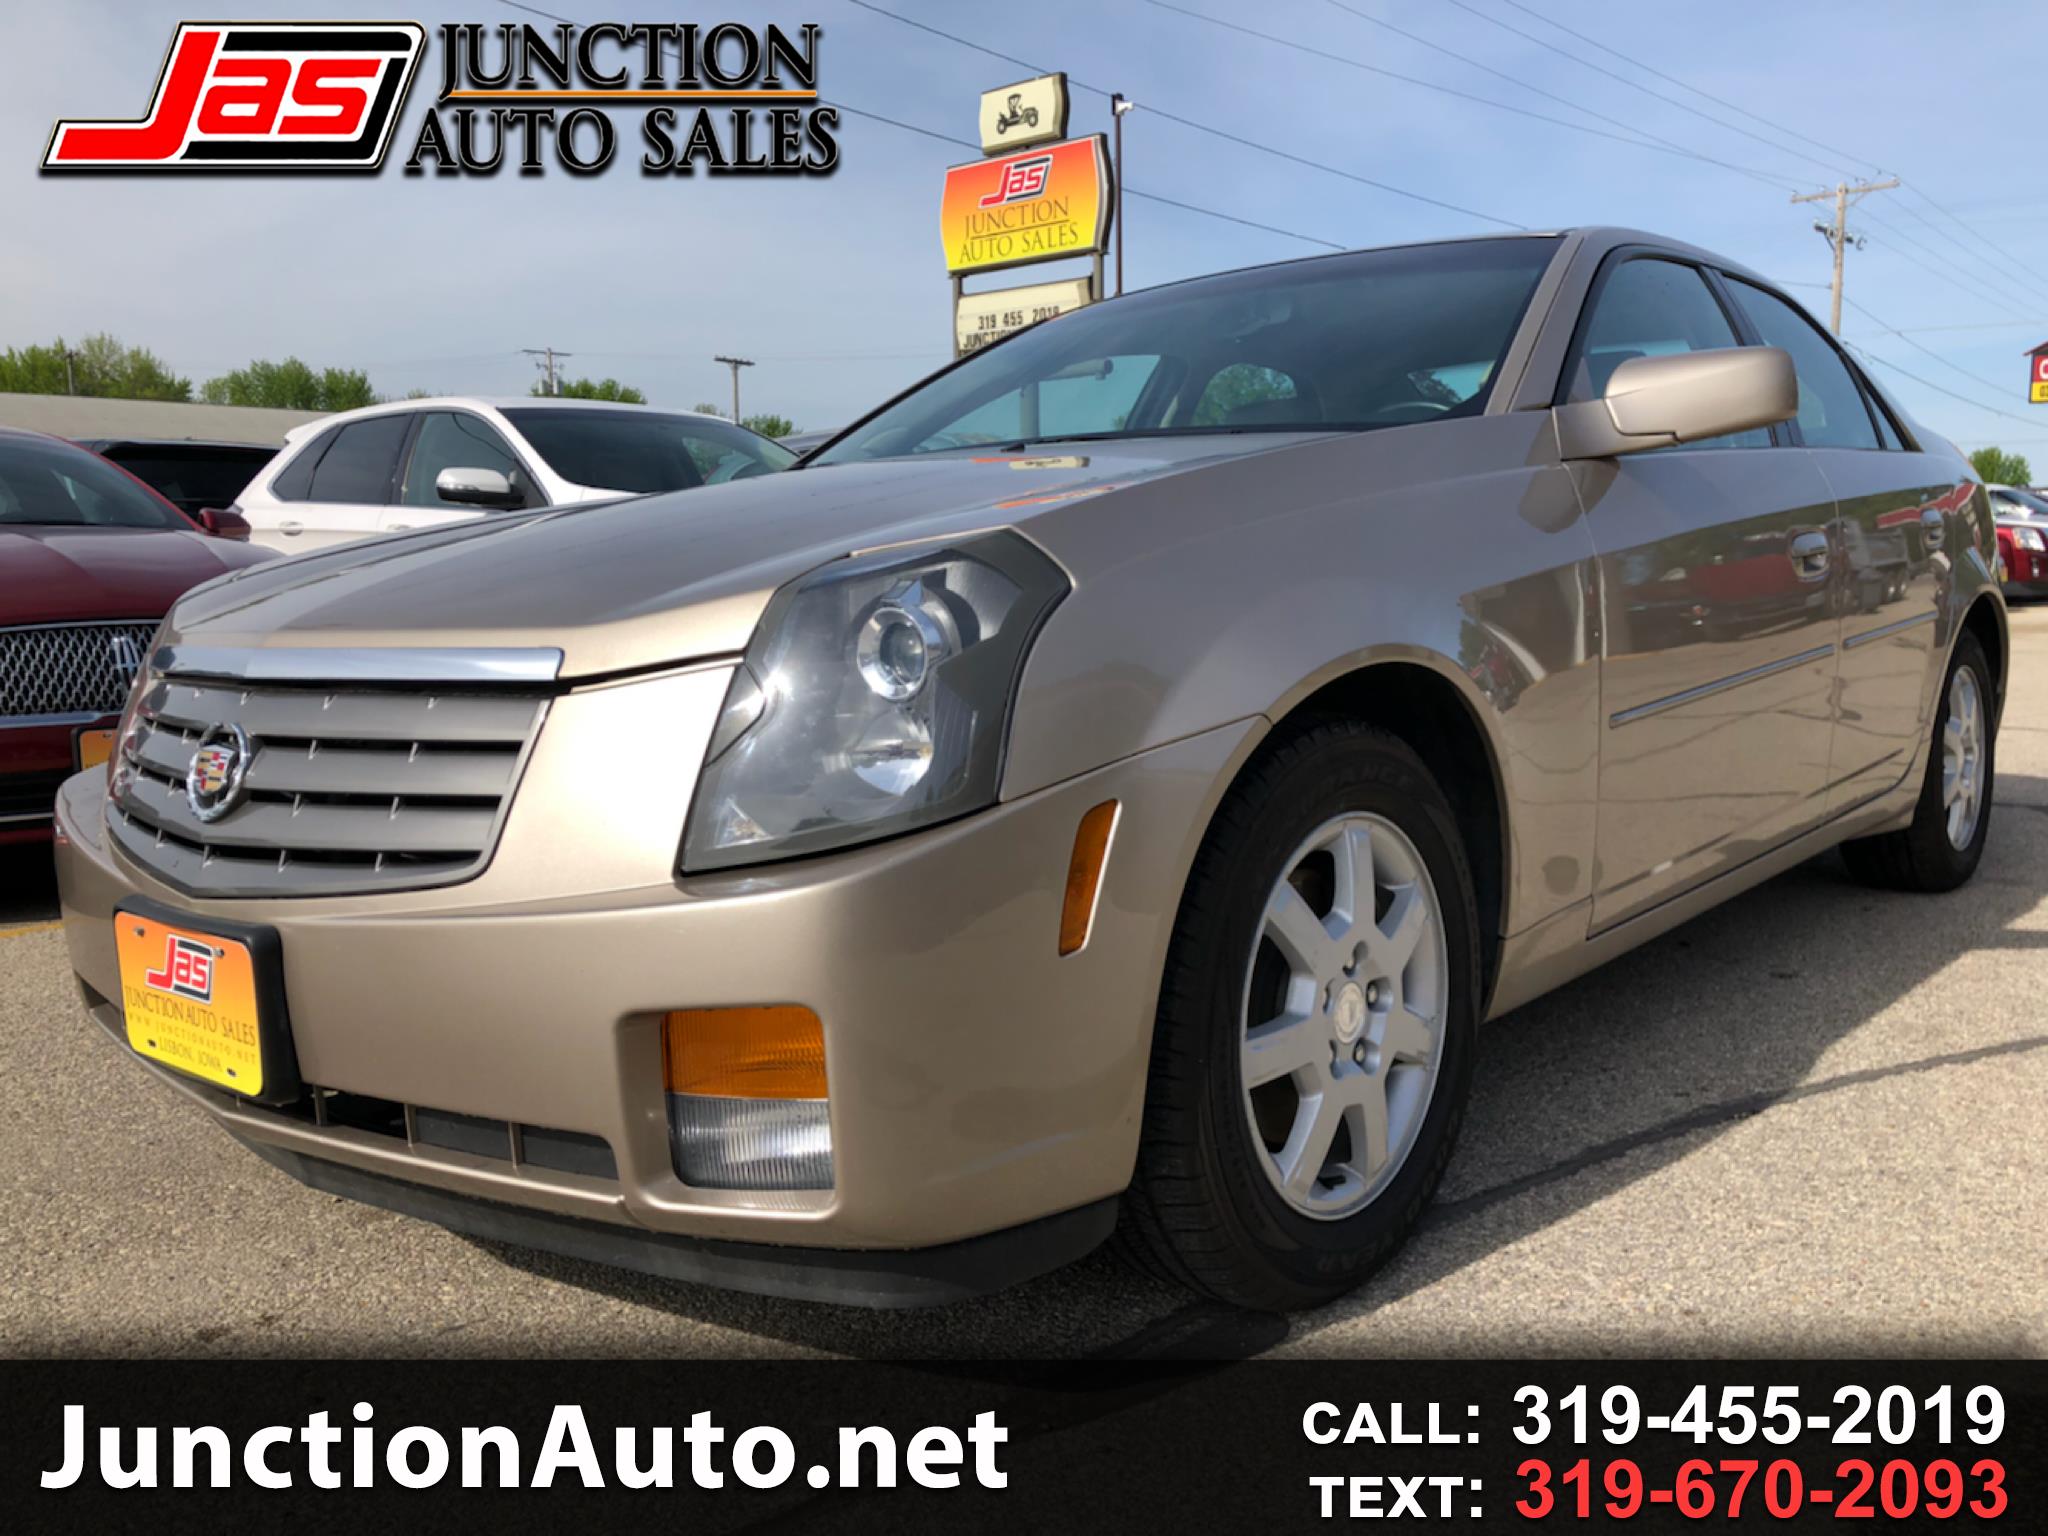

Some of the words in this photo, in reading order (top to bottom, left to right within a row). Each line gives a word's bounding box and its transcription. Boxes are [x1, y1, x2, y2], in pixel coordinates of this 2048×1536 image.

[964, 196, 1070, 240] JUNCTION
[959, 235, 1013, 264] AUTO
[1021, 222, 1079, 253] SALES
[977, 314, 997, 330] 319
[1002, 310, 1024, 327] 455
[124, 985, 184, 1021] JUNCTION
[185, 1005, 218, 1033] AUTO
[221, 1016, 256, 1047] SALES
